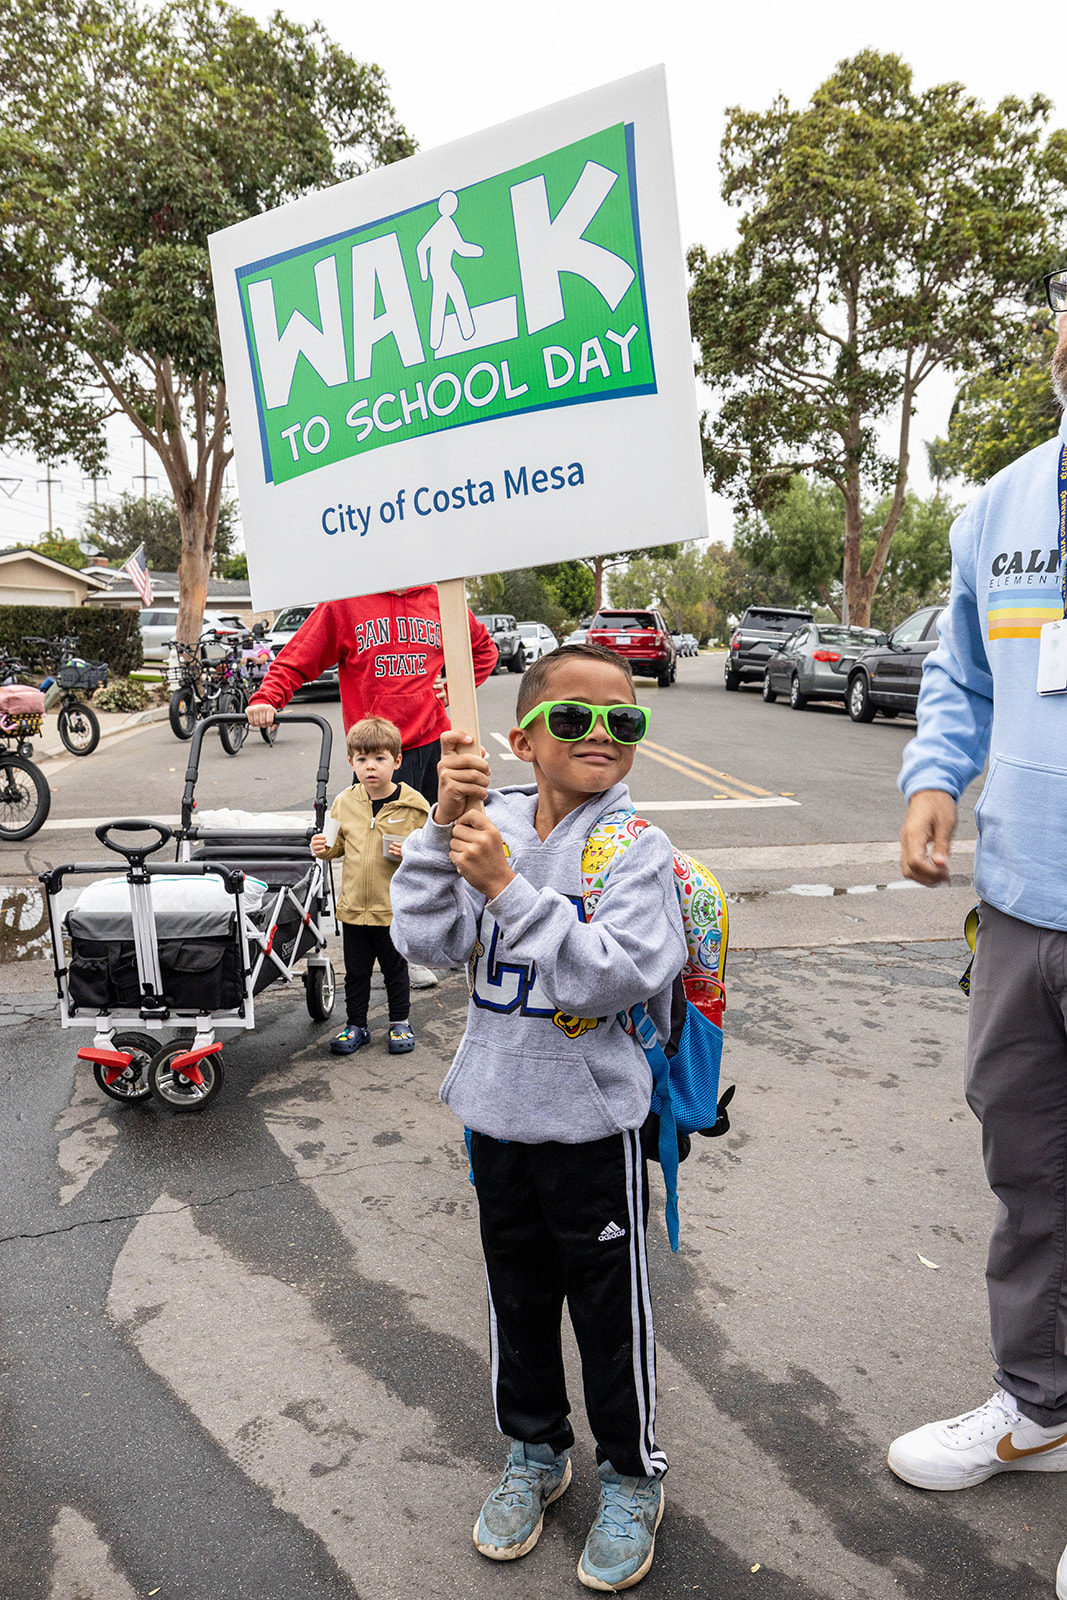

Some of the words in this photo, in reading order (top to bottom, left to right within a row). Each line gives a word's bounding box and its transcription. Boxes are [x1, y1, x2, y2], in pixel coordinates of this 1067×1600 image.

[247, 160, 636, 410] WALK
[281, 415, 331, 461] TO
[345, 360, 529, 443] SCHOOL
[542, 323, 640, 389] DAY
[321, 503, 371, 537] City
[379, 488, 406, 524] of
[414, 478, 495, 517] Costa
[504, 461, 585, 498] Mesa
[355, 617, 390, 654] SAN
[396, 616, 441, 649] DIEGO
[375, 653, 427, 677] STATE
